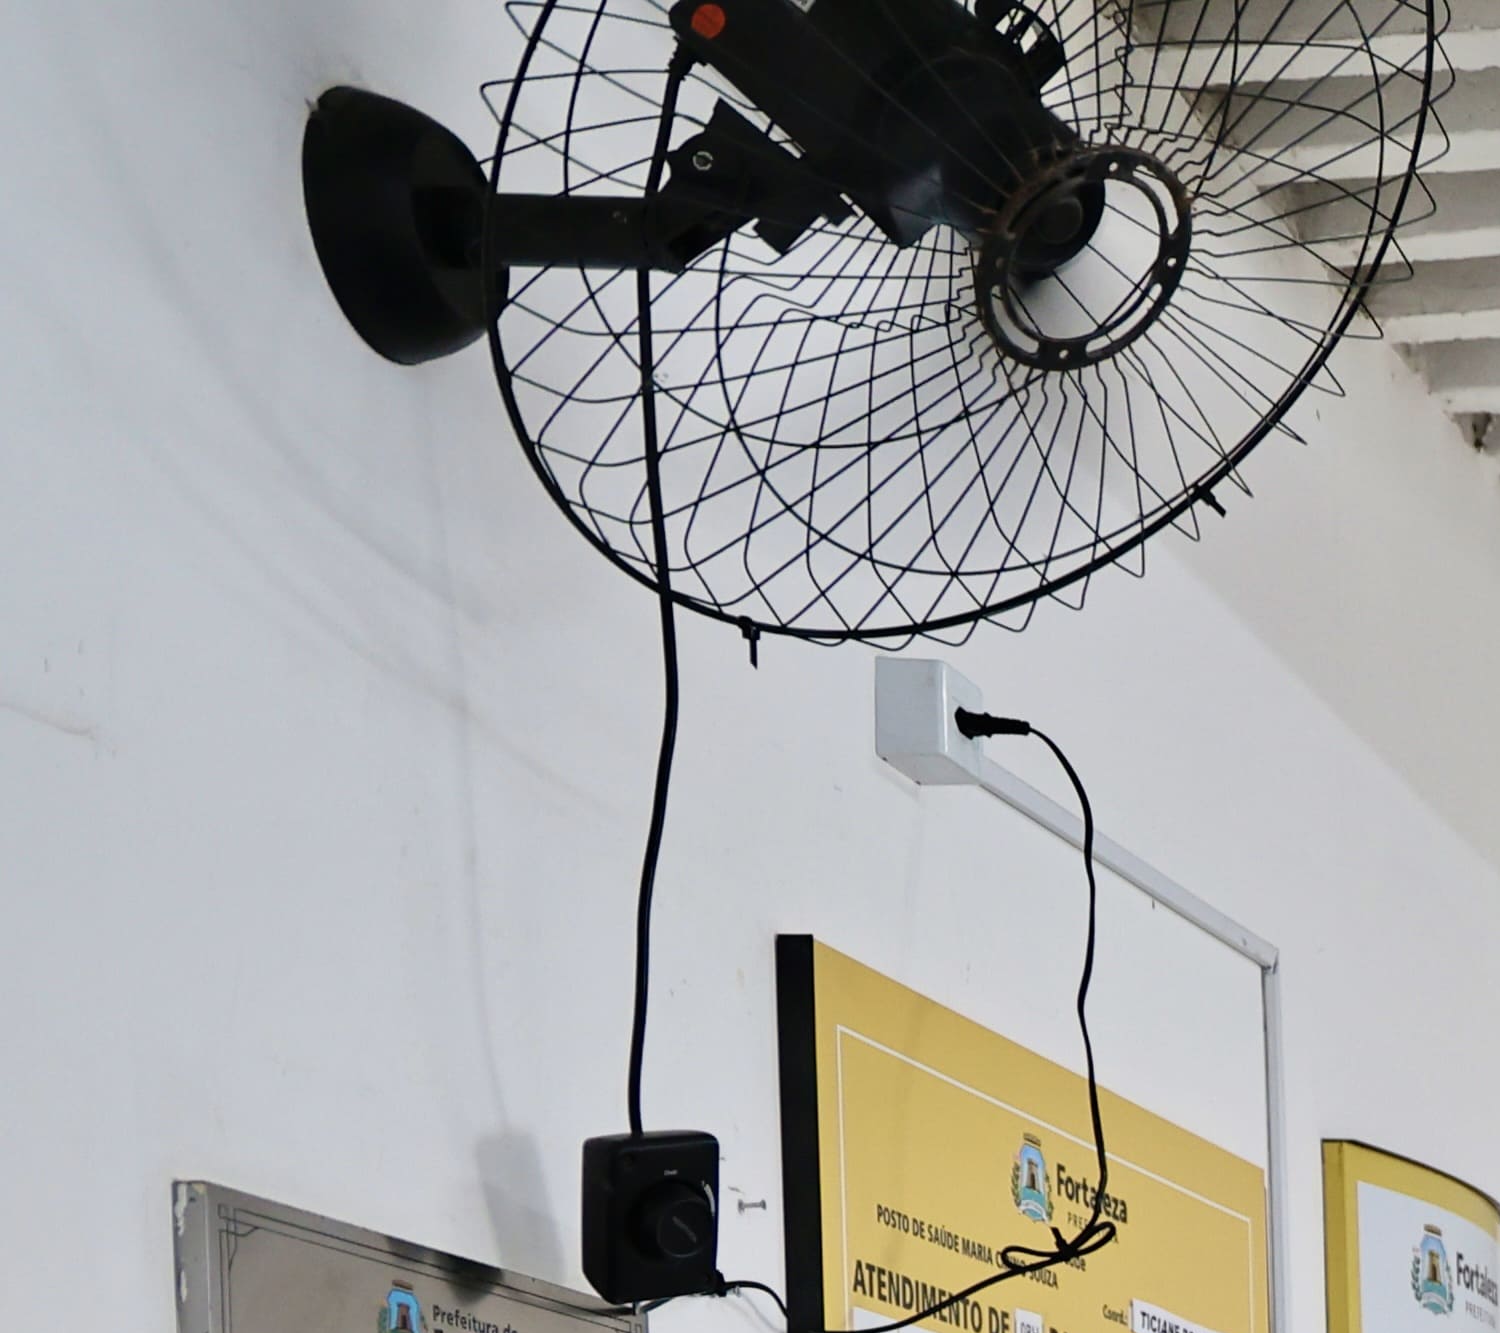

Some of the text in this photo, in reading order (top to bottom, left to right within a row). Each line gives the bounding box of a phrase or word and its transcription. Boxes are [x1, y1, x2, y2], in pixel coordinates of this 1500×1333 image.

[1056, 1163, 1128, 1224] Fortaeza
[877, 1204, 910, 1233] POSTO
[912, 1218, 926, 1239] DE
[927, 1225, 960, 1253] SAÚDE
[961, 1237, 994, 1267] MARIA
[853, 1259, 983, 1333] ATENDIMENTO
